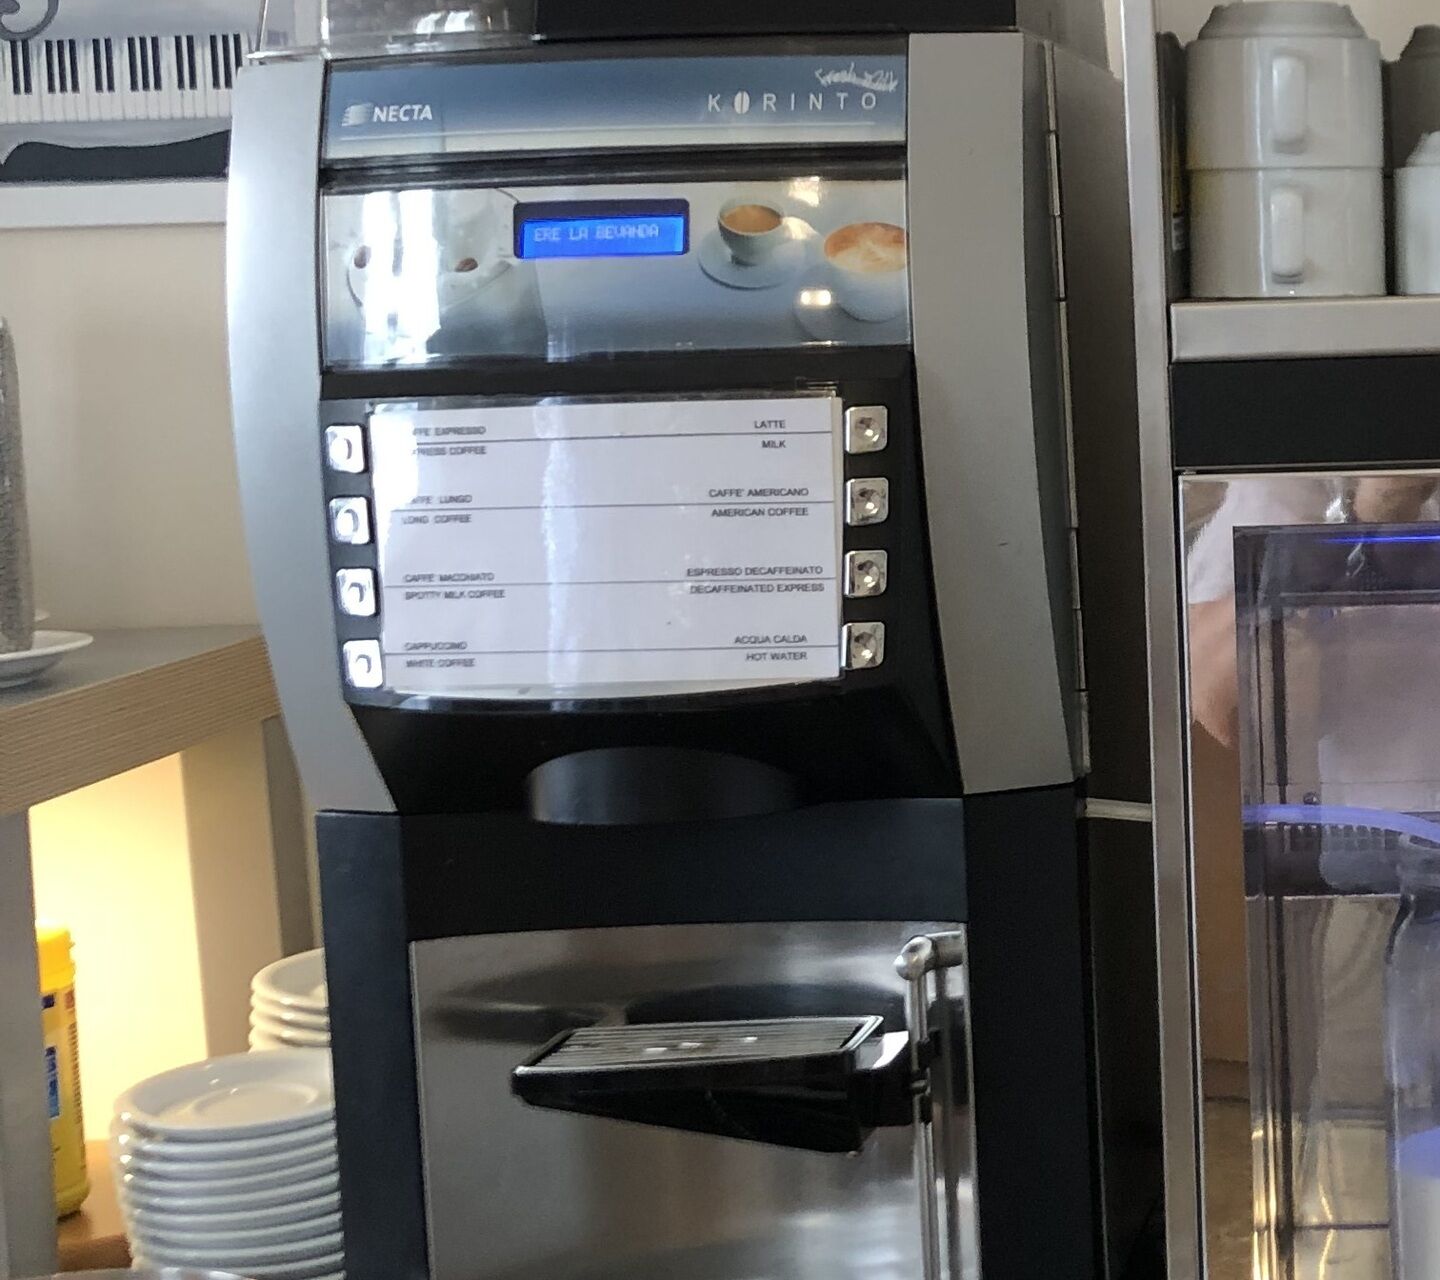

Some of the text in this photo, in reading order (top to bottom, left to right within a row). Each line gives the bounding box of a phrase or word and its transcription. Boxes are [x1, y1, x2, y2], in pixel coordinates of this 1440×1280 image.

[707, 90, 877, 114] KORINTO
[372, 104, 433, 123] NECTA
[753, 419, 787, 430] LATTE
[761, 439, 787, 449] MILK
[747, 487, 810, 498] AMERICANO
[711, 506, 810, 518] AMERICAN COFFEE
[686, 565, 824, 578] ESPRESSO DECAFFEINATO
[466, 588, 506, 599] COFFEE
[689, 582, 825, 595] DECAFFEINATED EXPRESS
[734, 634, 808, 645] ACQUA CALDA
[745, 650, 808, 662] HOT WATER
